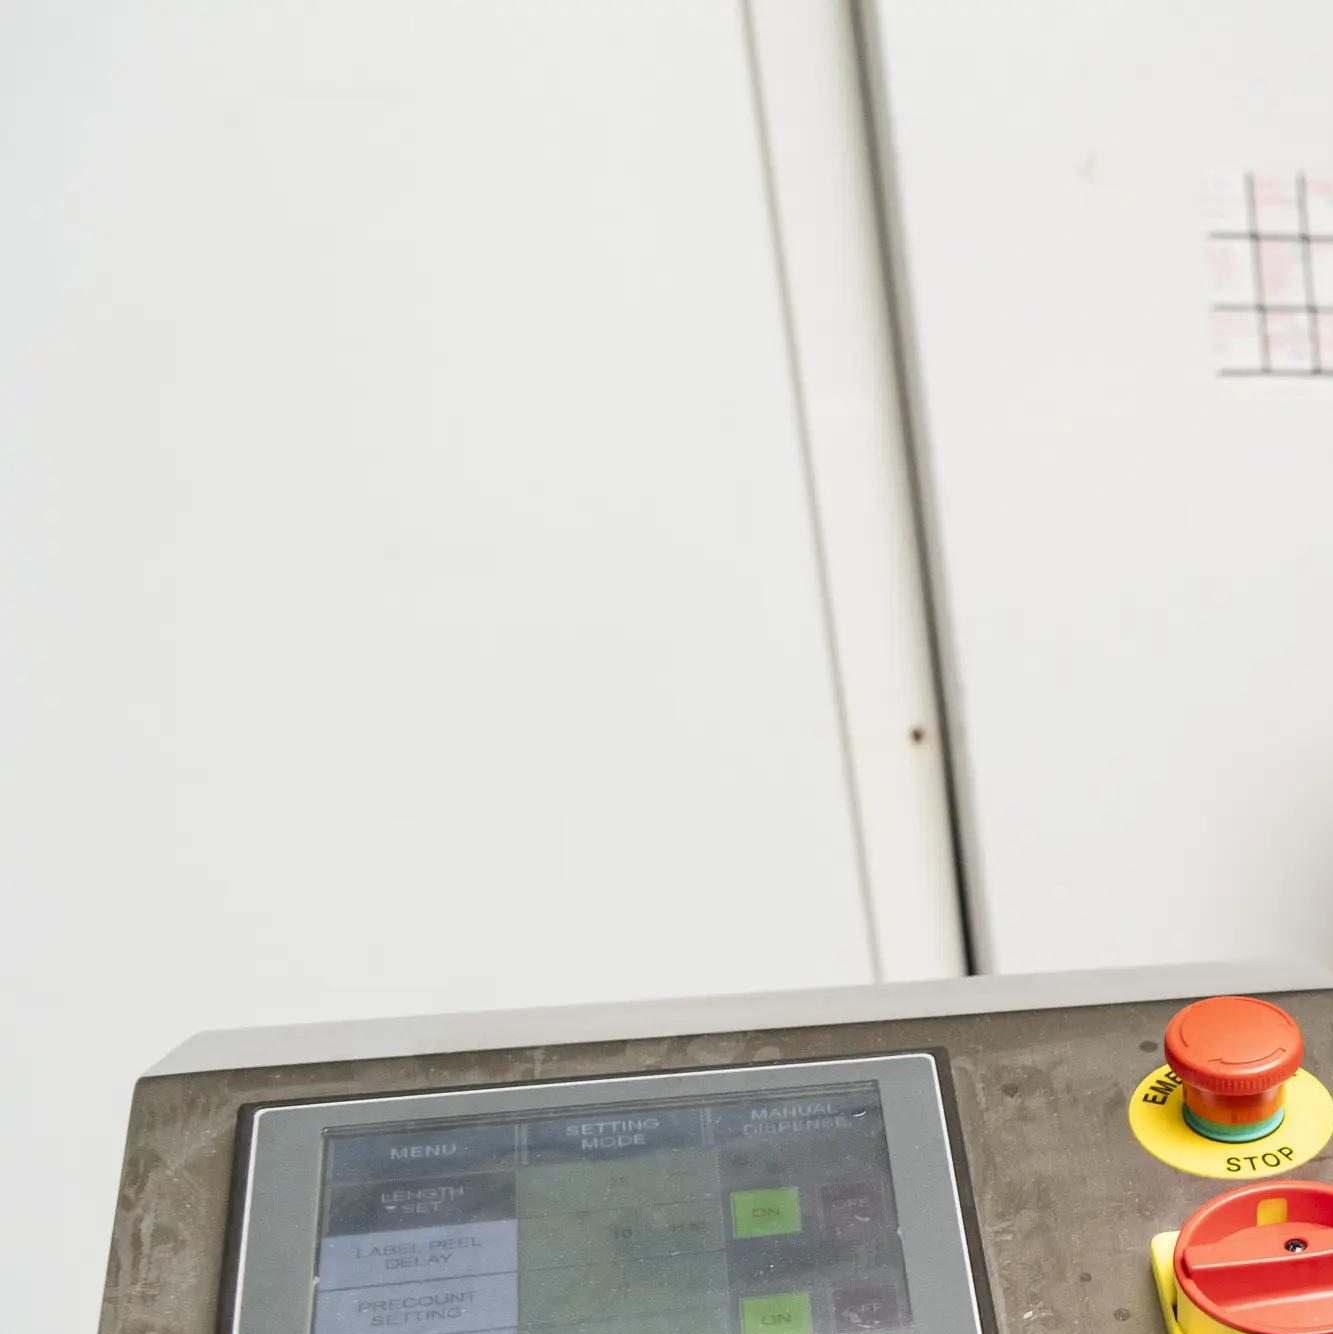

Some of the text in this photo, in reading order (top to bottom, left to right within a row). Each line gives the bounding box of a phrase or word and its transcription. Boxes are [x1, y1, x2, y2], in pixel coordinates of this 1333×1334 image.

[751, 1103, 839, 1121] MANUAL
[566, 1118, 660, 1136] SETTING
[743, 1115, 850, 1136] DISPENSE
[581, 1134, 647, 1150] MODE
[390, 1144, 456, 1160] MENU
[1226, 1146, 1294, 1173] STOP
[381, 1186, 465, 1203] LENGTH
[400, 1201, 441, 1213] SET
[752, 1207, 780, 1218] ON
[357, 1236, 483, 1259] LABEL PEEL
[384, 1252, 453, 1270] DELAY
[357, 1290, 477, 1313] PRECOUNT
[370, 1307, 462, 1327] SETTING
[761, 1313, 792, 1326] ON
